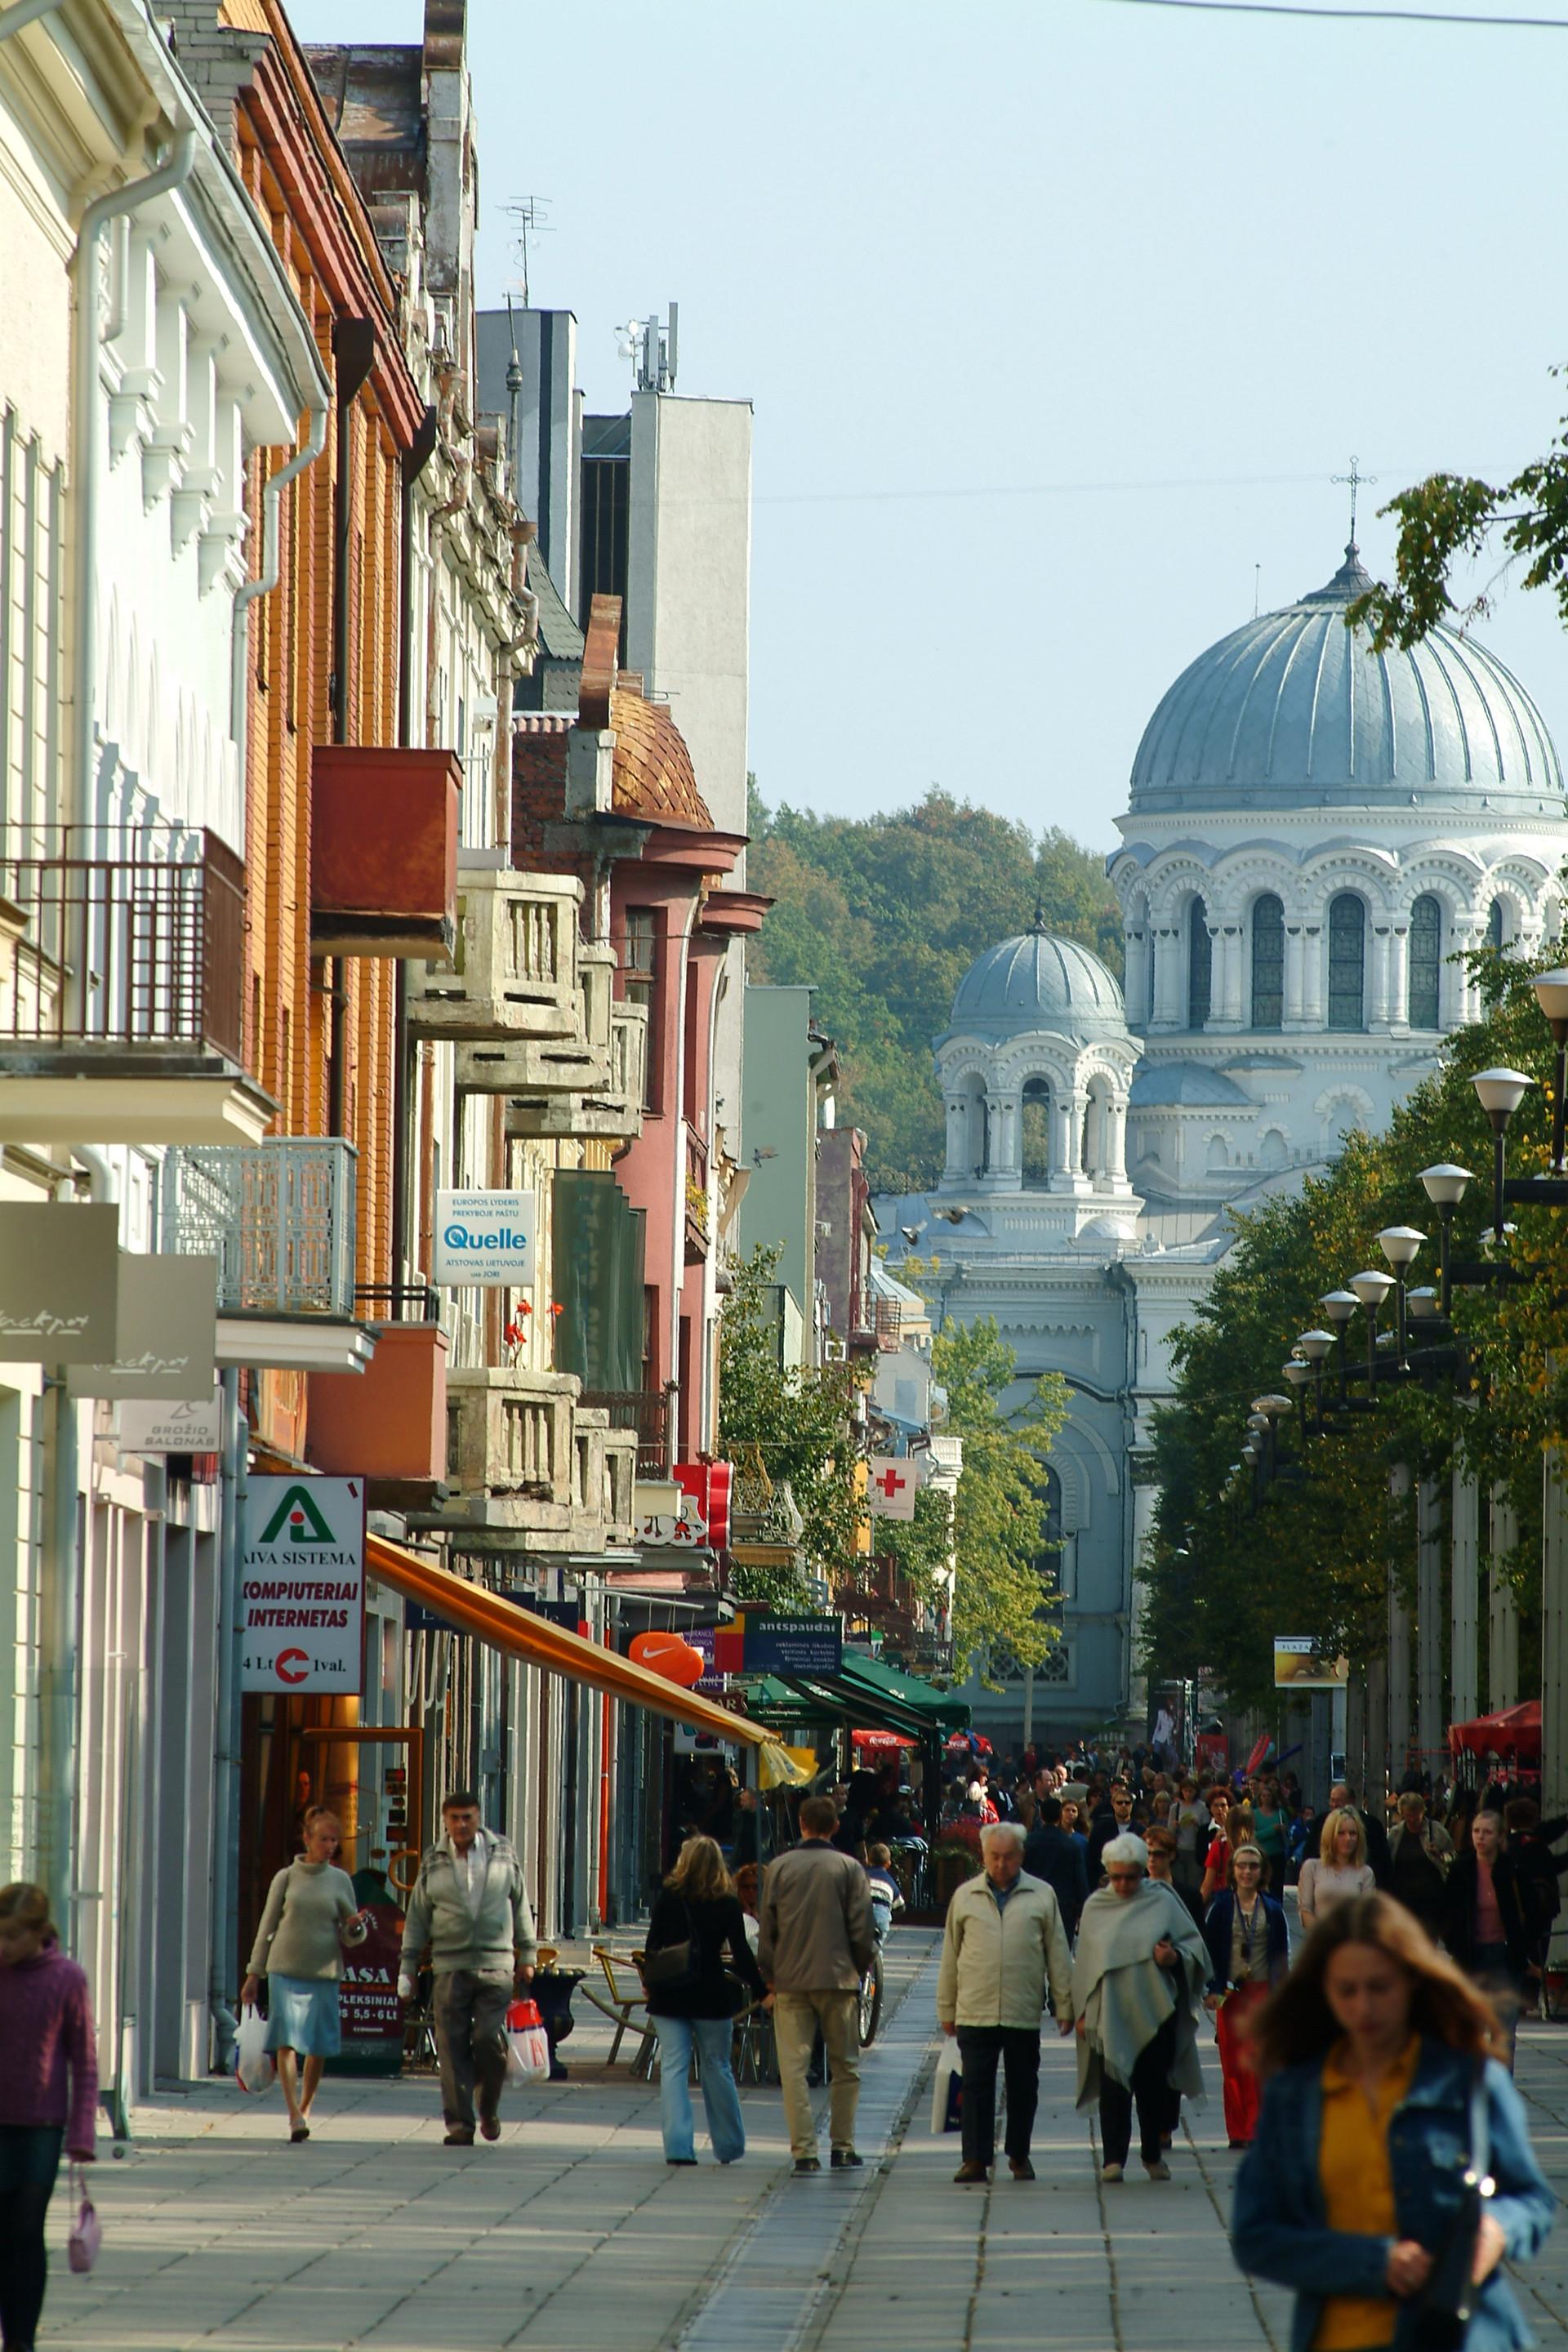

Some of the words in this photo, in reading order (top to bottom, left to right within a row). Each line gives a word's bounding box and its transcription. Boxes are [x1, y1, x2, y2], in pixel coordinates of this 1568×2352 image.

[443, 1224, 527, 1250] Quelle
[145, 1437, 215, 1446] SALONAS
[283, 1552, 356, 1565] SISTEMA
[247, 1608, 348, 1628] INTERNETAS
[759, 1622, 835, 1633] antspaudai
[256, 1657, 274, 1670] Lt
[354, 2009, 370, 2020] 5,5
